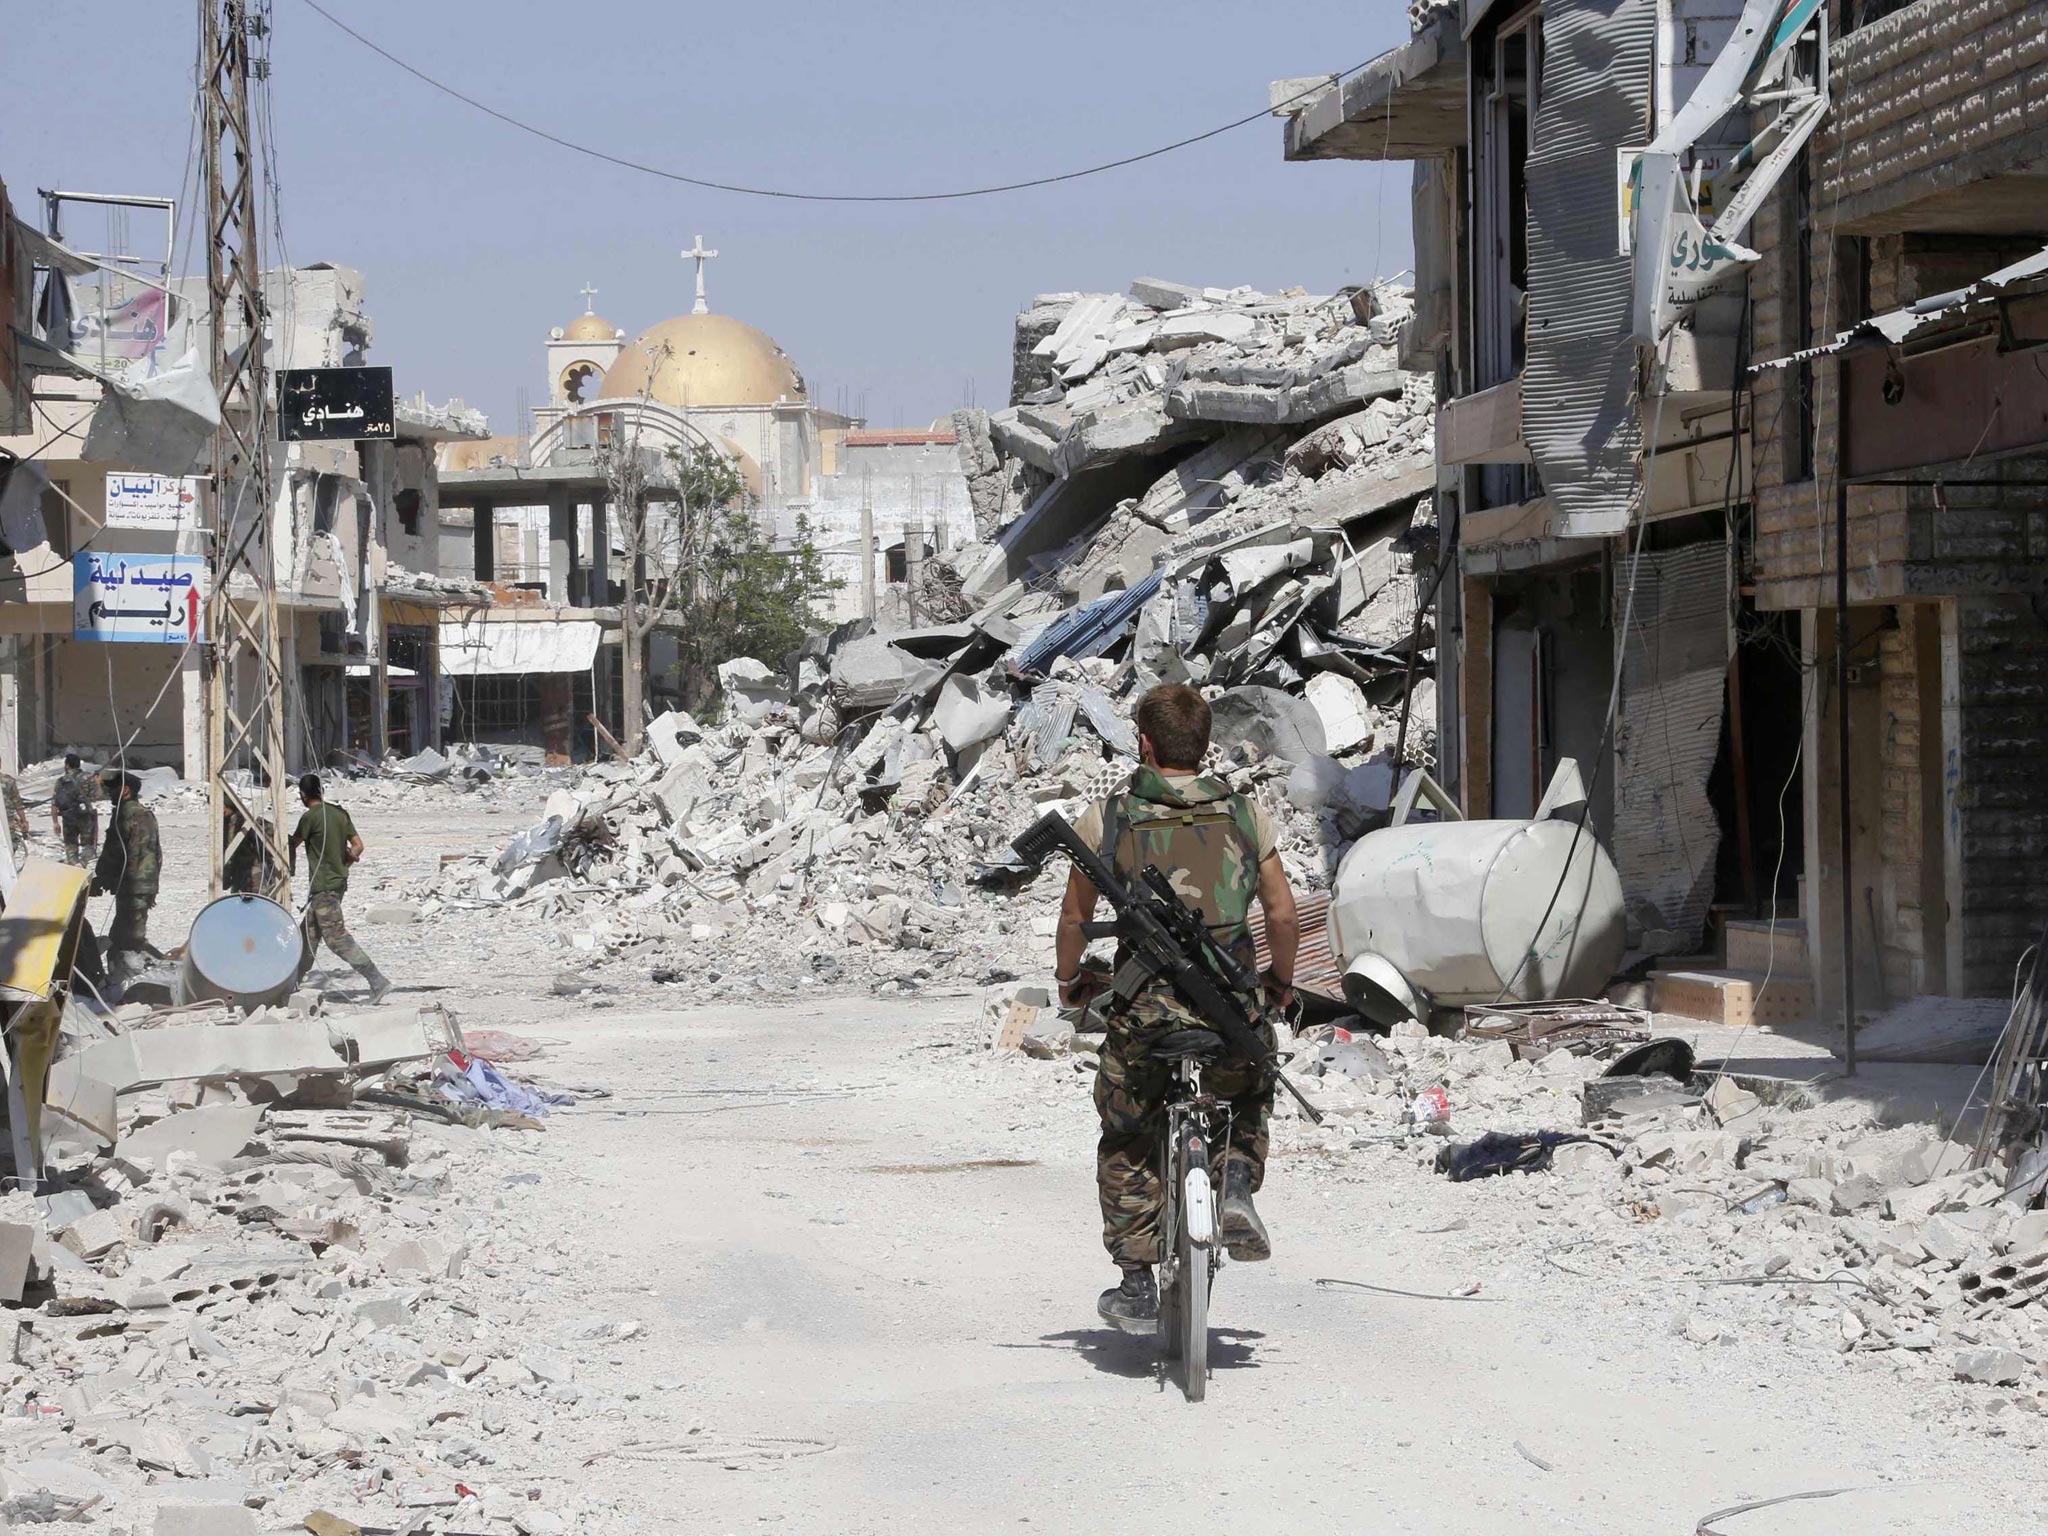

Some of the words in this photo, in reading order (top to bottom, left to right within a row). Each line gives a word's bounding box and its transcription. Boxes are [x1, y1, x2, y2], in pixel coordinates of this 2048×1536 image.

[302, 402, 364, 426] هنادي
[110, 478, 160, 498] البيان
[161, 480, 186, 495] مركز
[88, 557, 193, 592] صيدلية
[88, 600, 186, 628] ريم
